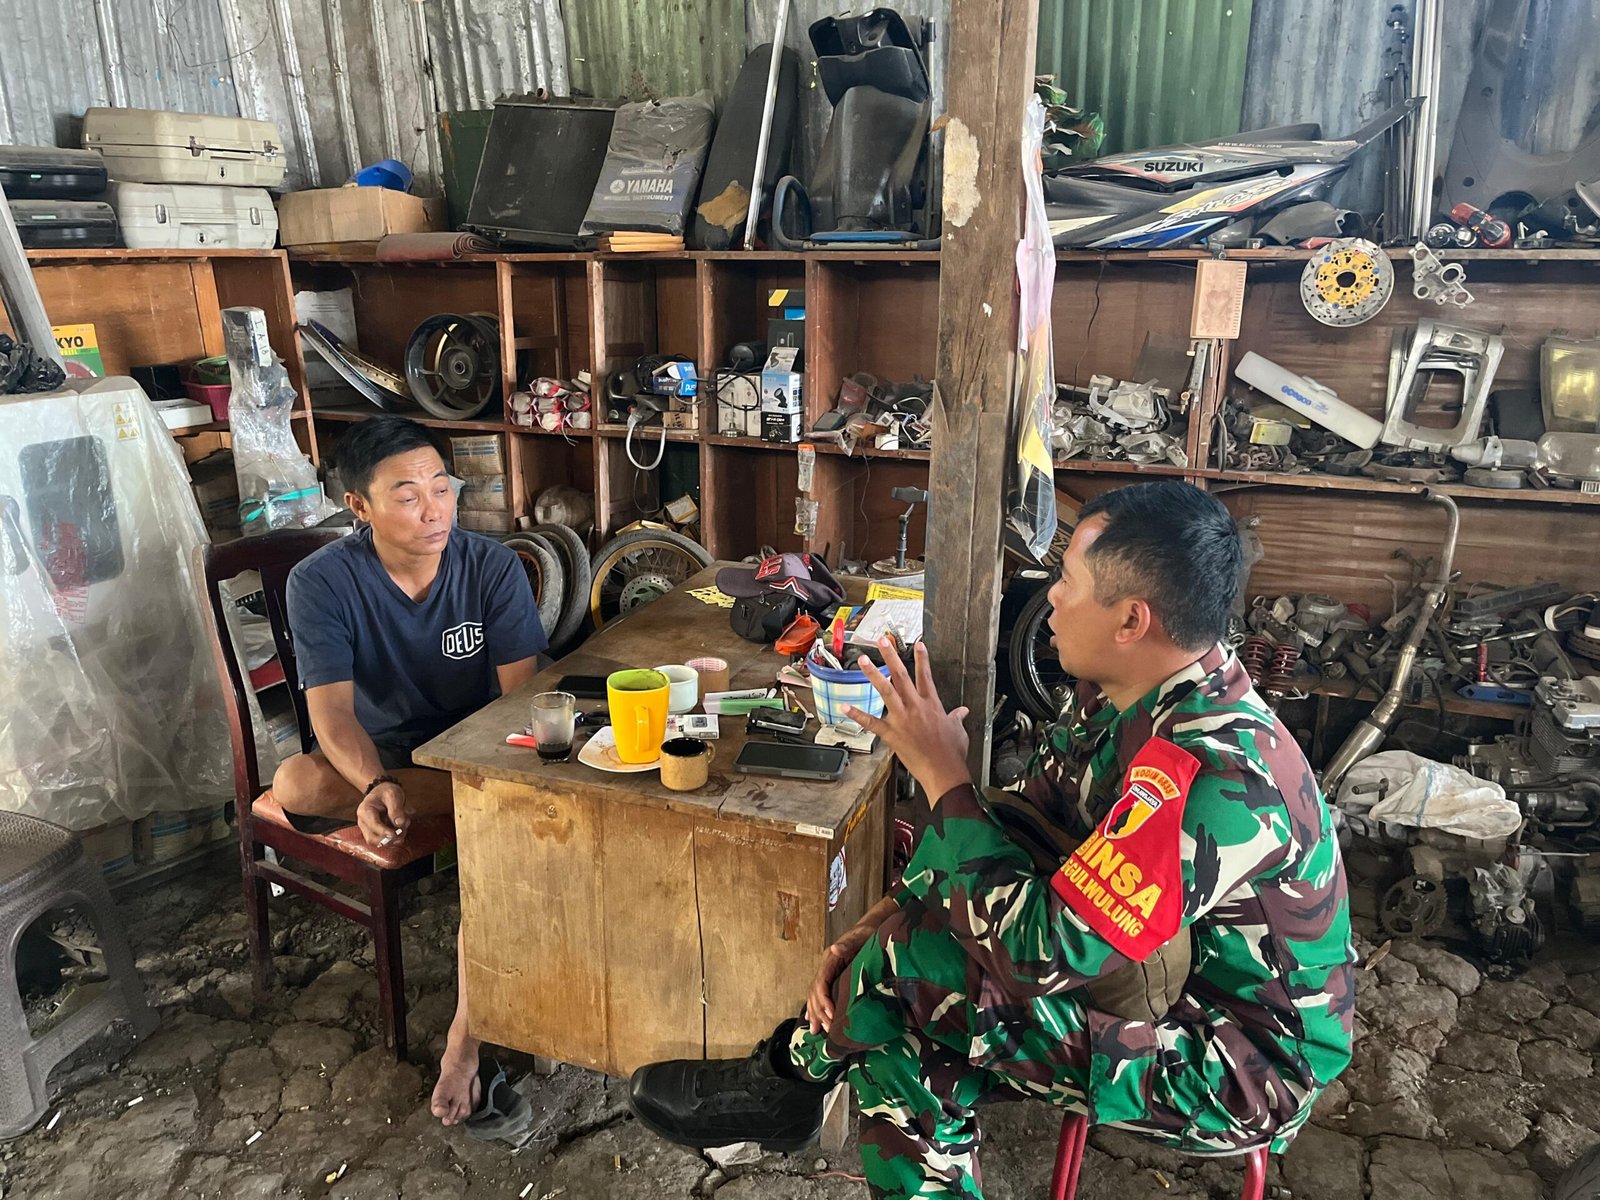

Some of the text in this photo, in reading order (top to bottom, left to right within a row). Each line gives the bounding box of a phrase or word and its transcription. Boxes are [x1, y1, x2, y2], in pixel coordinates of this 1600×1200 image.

[1144, 161, 1203, 173] SUZUKI
[626, 179, 674, 194] YAMAHA
[446, 626, 484, 654] DEUS
